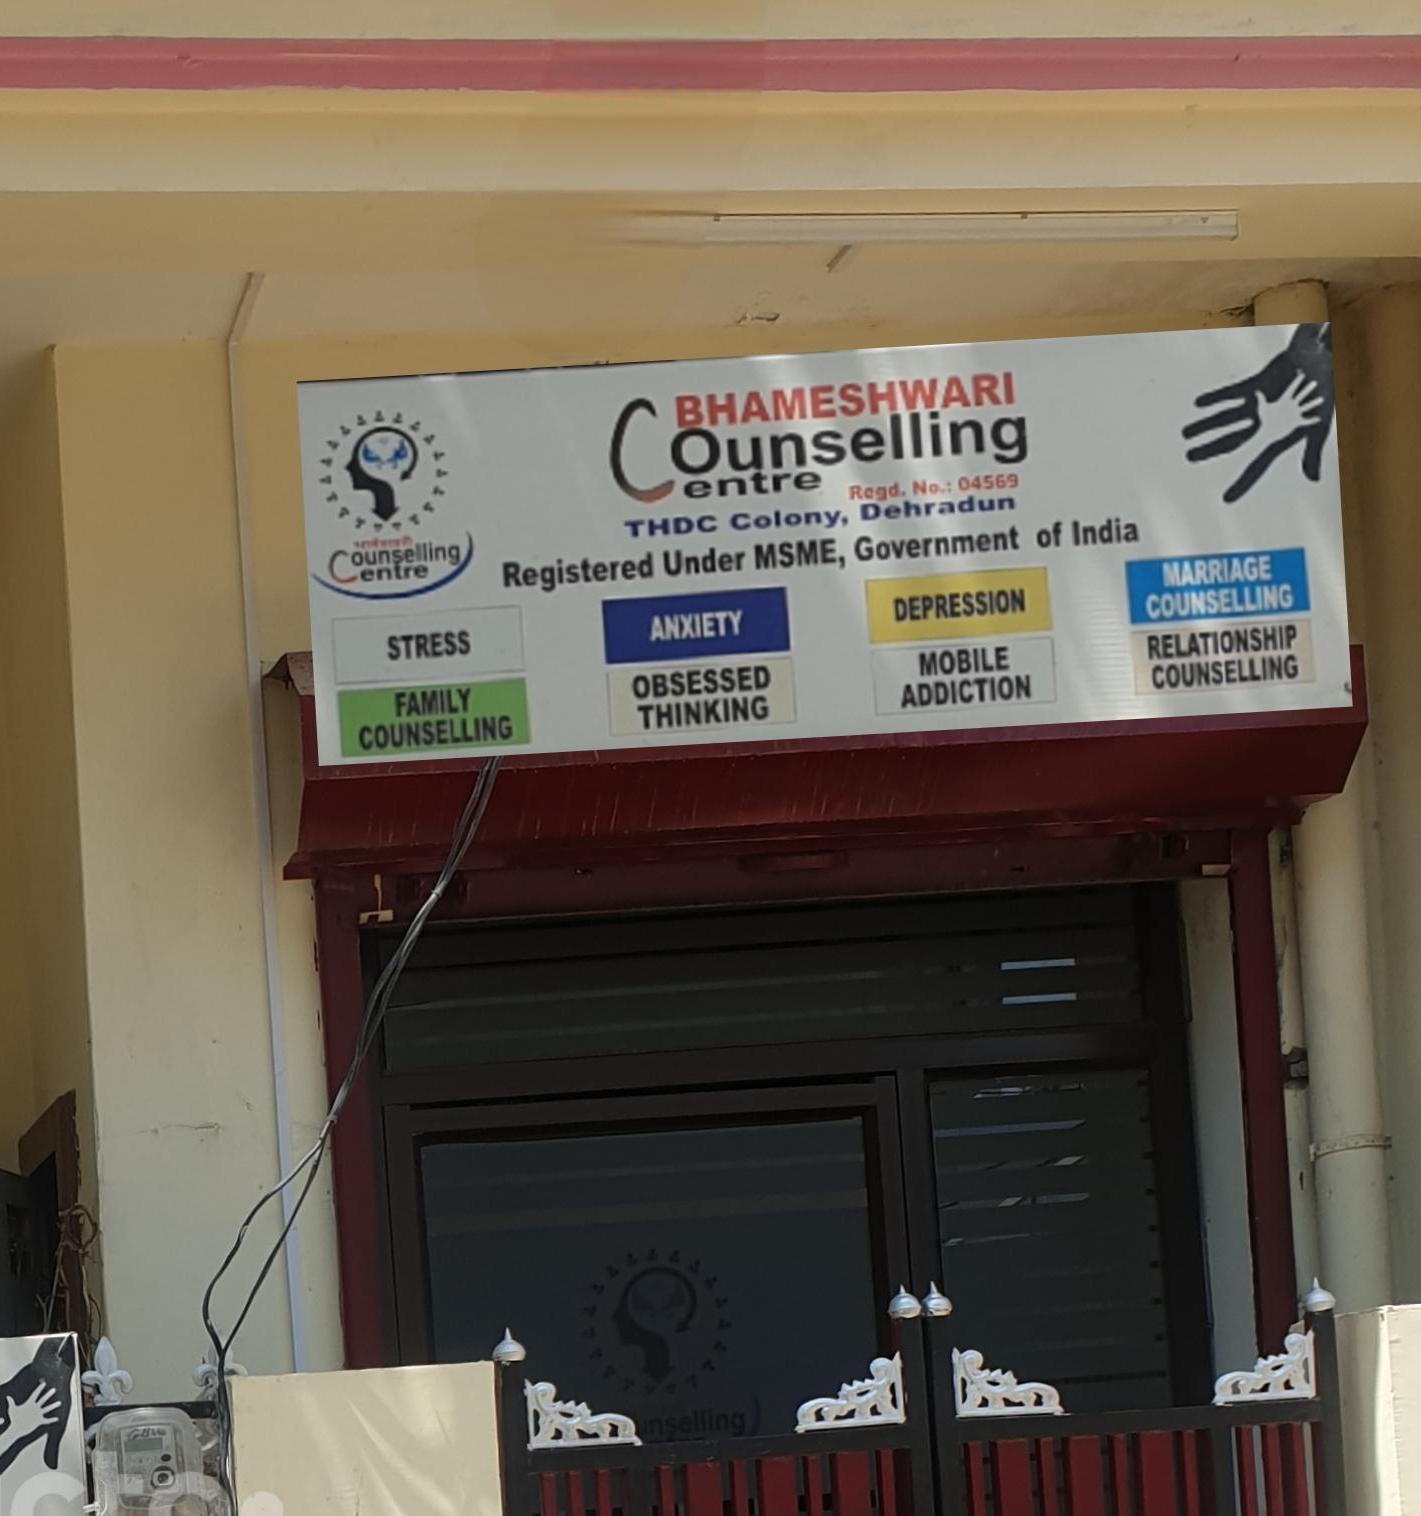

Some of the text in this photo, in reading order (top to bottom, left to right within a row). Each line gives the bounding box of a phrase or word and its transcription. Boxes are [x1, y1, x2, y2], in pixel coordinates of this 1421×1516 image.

[674, 371, 1016, 429] BHAMESHWARI
[848, 481, 907, 502] Regd.
[957, 472, 1020, 491] 04569
[623, 496, 1016, 539] THDC Colony, Dehradun
[502, 516, 1140, 593] Registered Under MSME, Government of India
[1161, 554, 1273, 588] MARRIAGE
[893, 588, 1026, 623] DEPRESSION
[1145, 584, 1294, 621] COUNSELLING
[649, 609, 743, 642] ANXIETY
[1147, 624, 1298, 661] RELATIONSHIP
[387, 630, 471, 661] STRESS
[918, 645, 1010, 676] MOBILE
[631, 664, 771, 700] OBSESSED
[1150, 654, 1299, 690] COUNSELLING
[394, 687, 471, 718] FAMILY
[900, 673, 1032, 709] ADDICTION
[637, 695, 770, 730] THINKING
[358, 715, 513, 751] COUNSELLING
